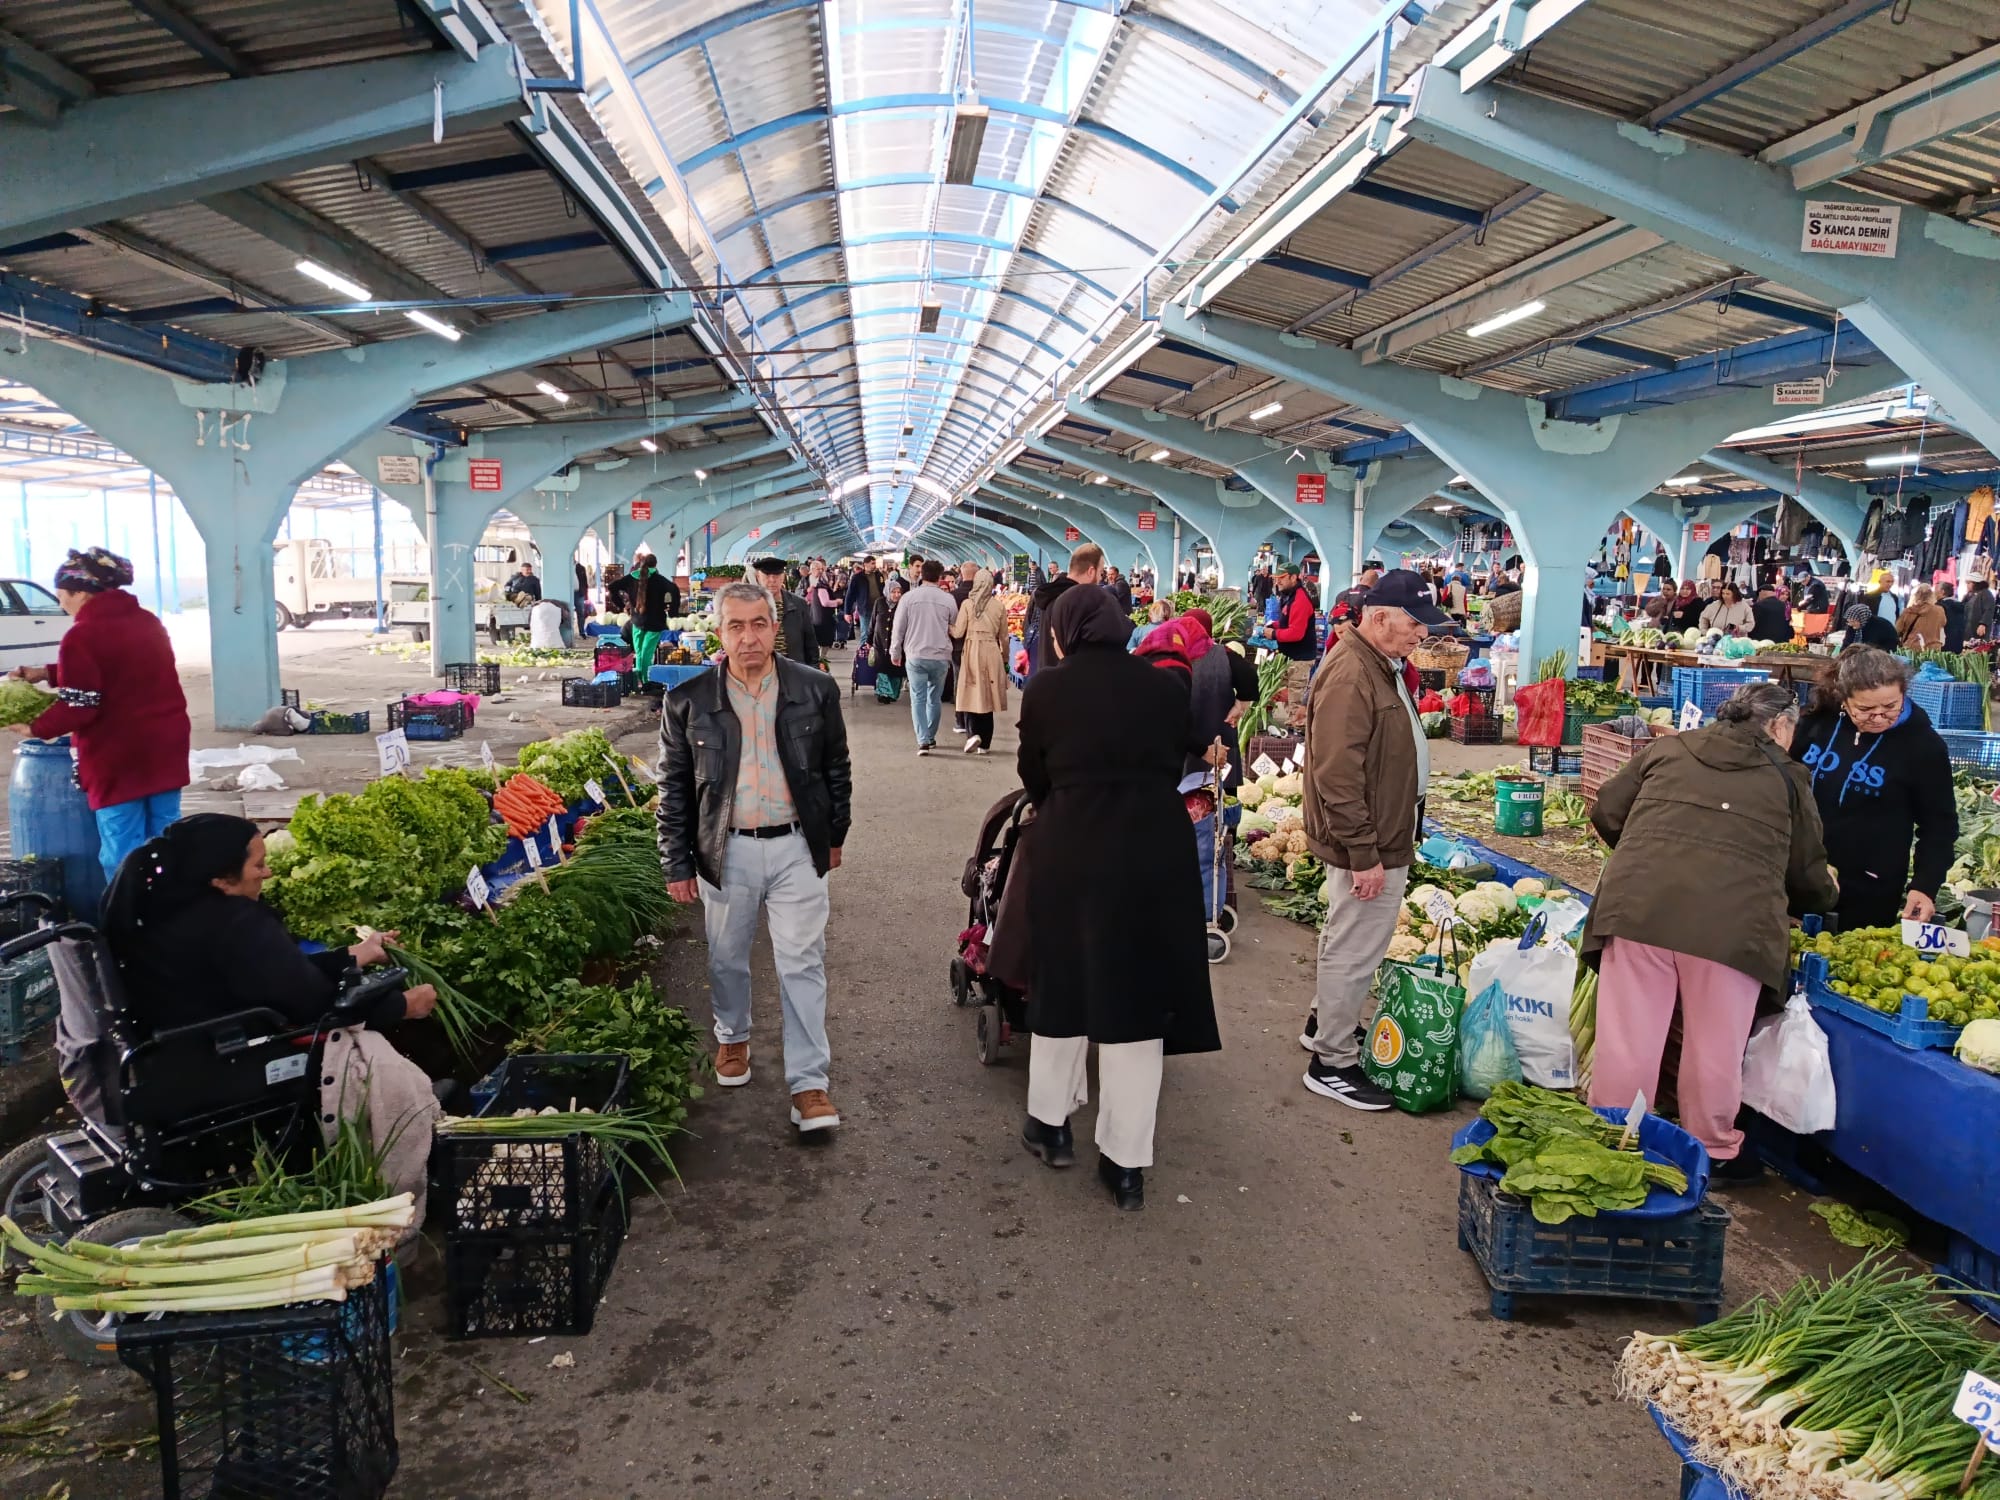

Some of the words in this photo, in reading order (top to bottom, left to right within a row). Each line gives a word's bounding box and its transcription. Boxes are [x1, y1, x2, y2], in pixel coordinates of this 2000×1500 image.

[1809, 220, 1821, 235] S
[1824, 224, 1856, 237] KANCA
[1858, 225, 1890, 239] DEMİRİ
